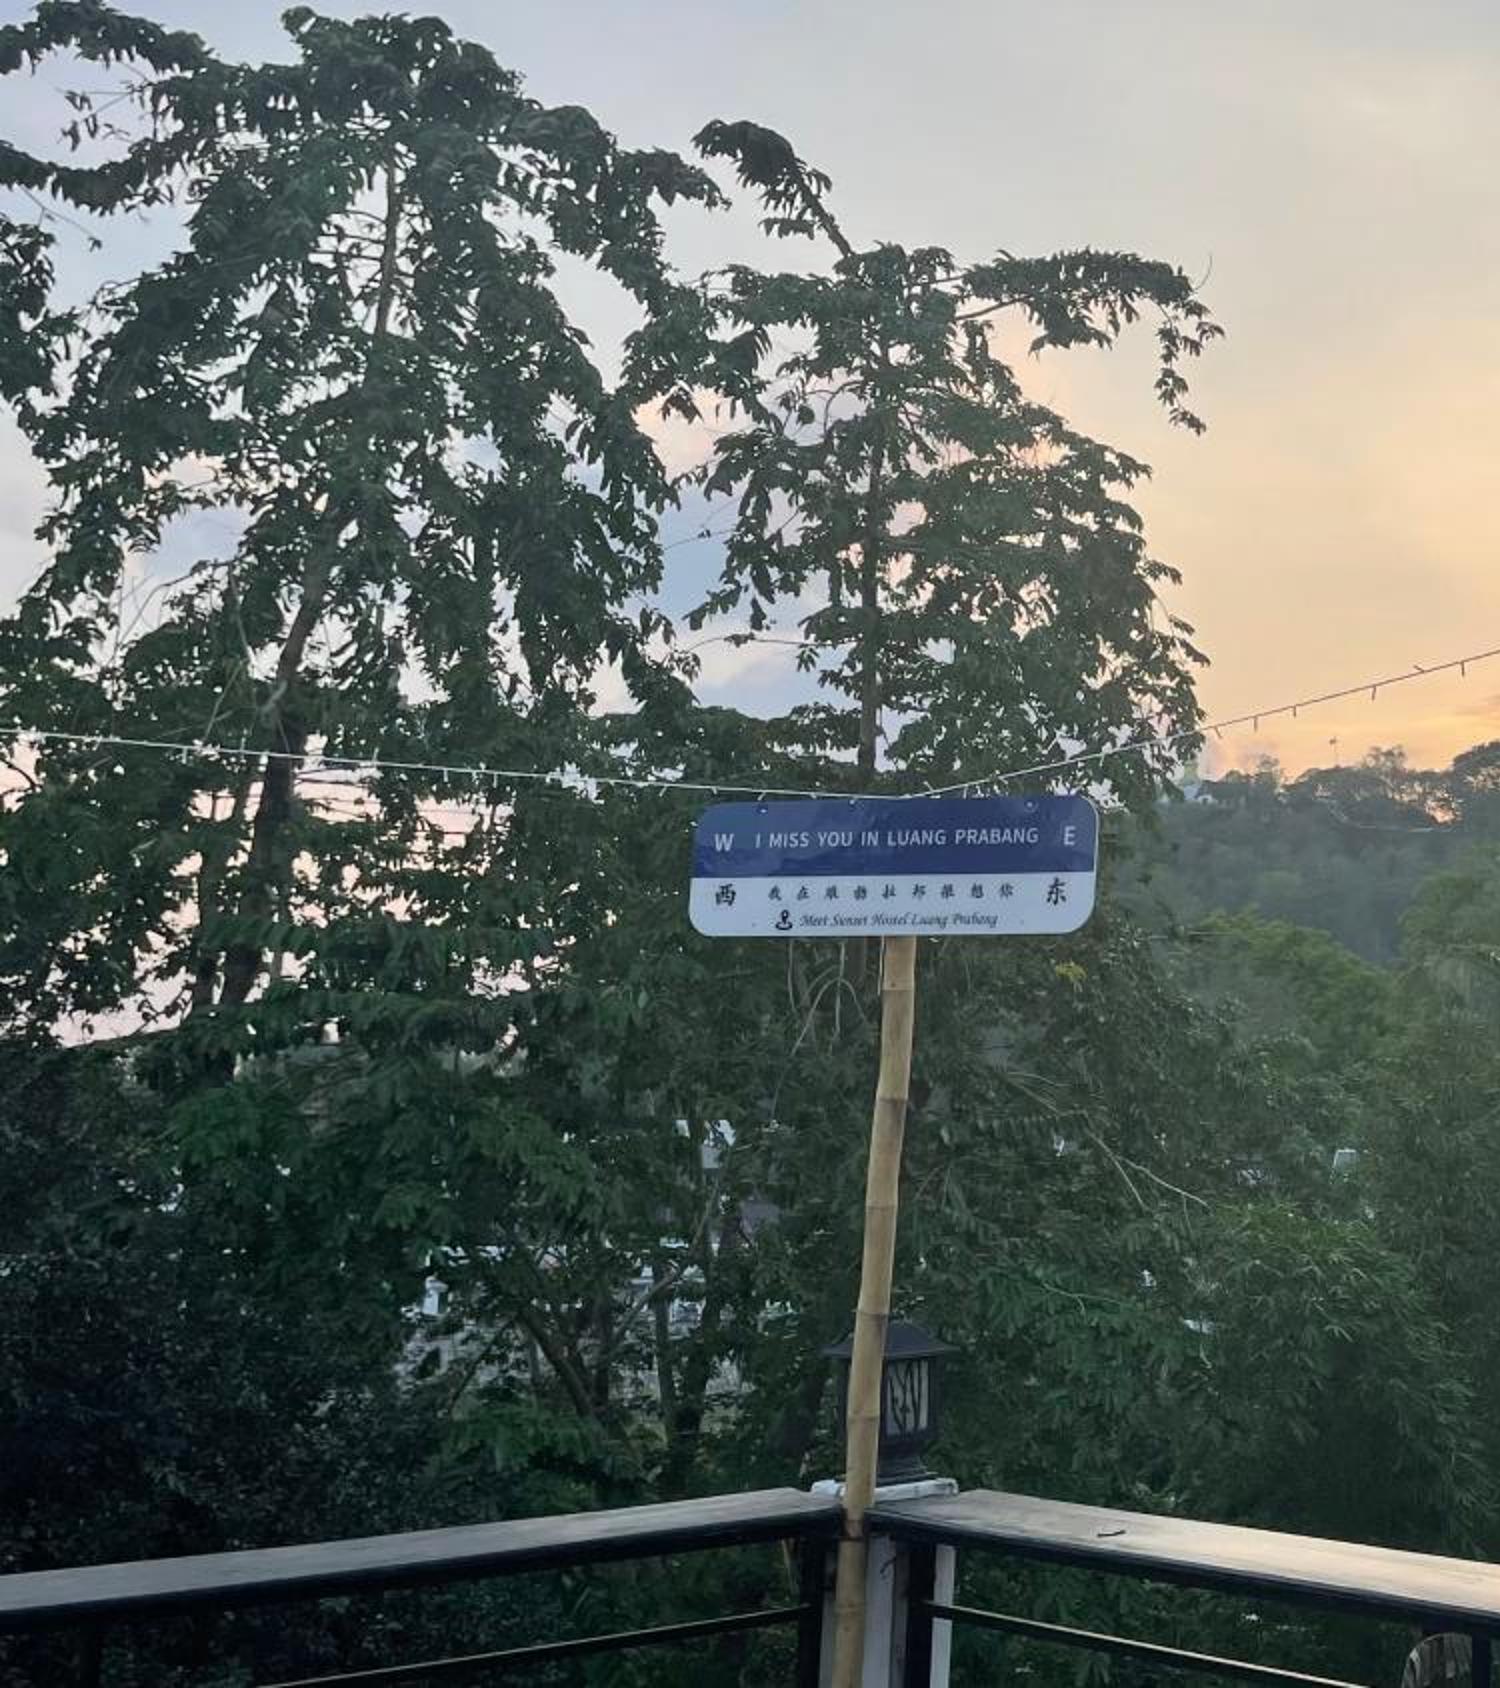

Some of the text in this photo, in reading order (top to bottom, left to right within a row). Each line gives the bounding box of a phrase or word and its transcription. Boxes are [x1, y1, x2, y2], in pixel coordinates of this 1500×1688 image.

[715, 833, 735, 852] W
[755, 827, 1039, 848] I MISS YOU IN LUANG PRABANG
[1063, 826, 1076, 846] E
[715, 884, 736, 906] 西
[1046, 877, 1068, 905] 东
[799, 912, 999, 929] Meet Sunset Hostel Luang Prabang
